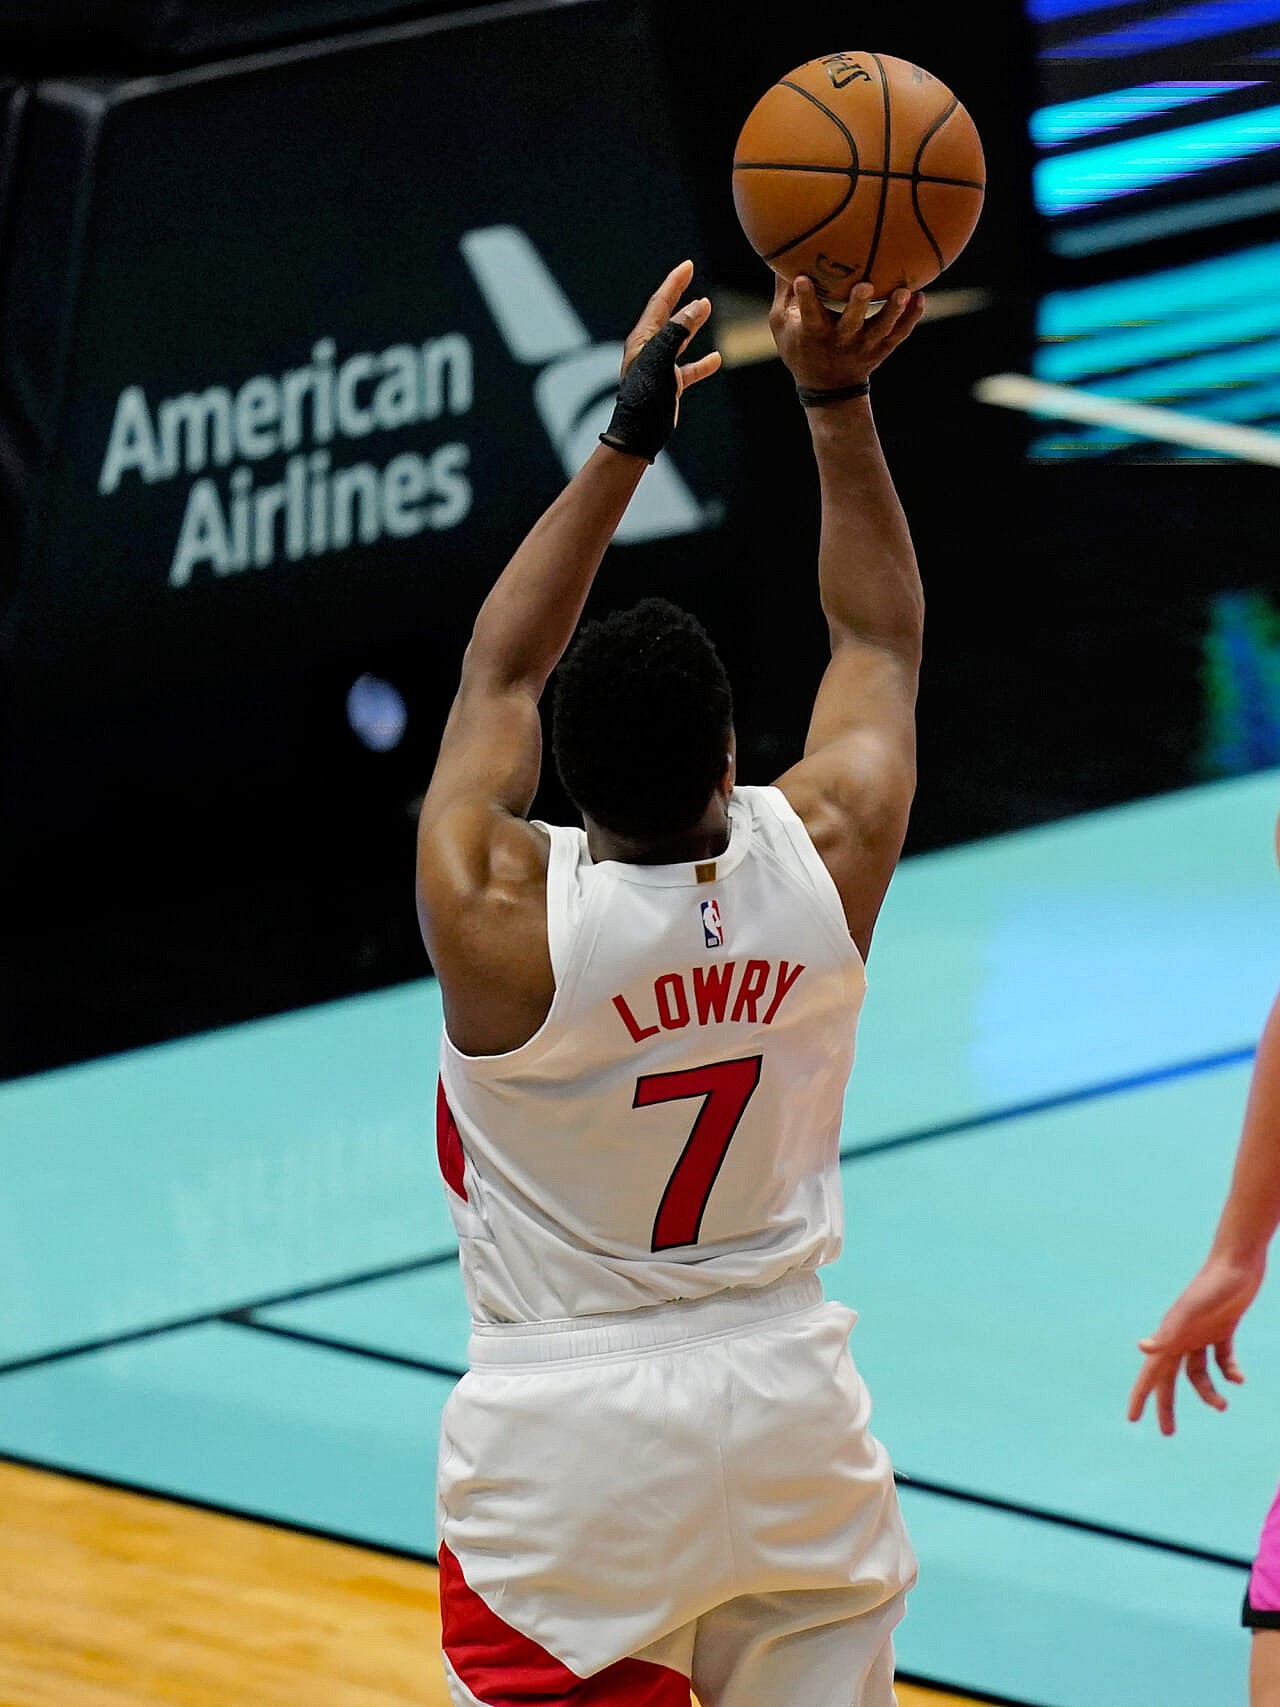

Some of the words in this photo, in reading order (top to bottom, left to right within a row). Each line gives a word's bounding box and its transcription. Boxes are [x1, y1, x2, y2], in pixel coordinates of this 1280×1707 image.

[100, 332, 474, 495] American
[168, 441, 474, 588] Airlines
[611, 959, 805, 1044] LOWRY
[631, 1054, 764, 1253] 7
